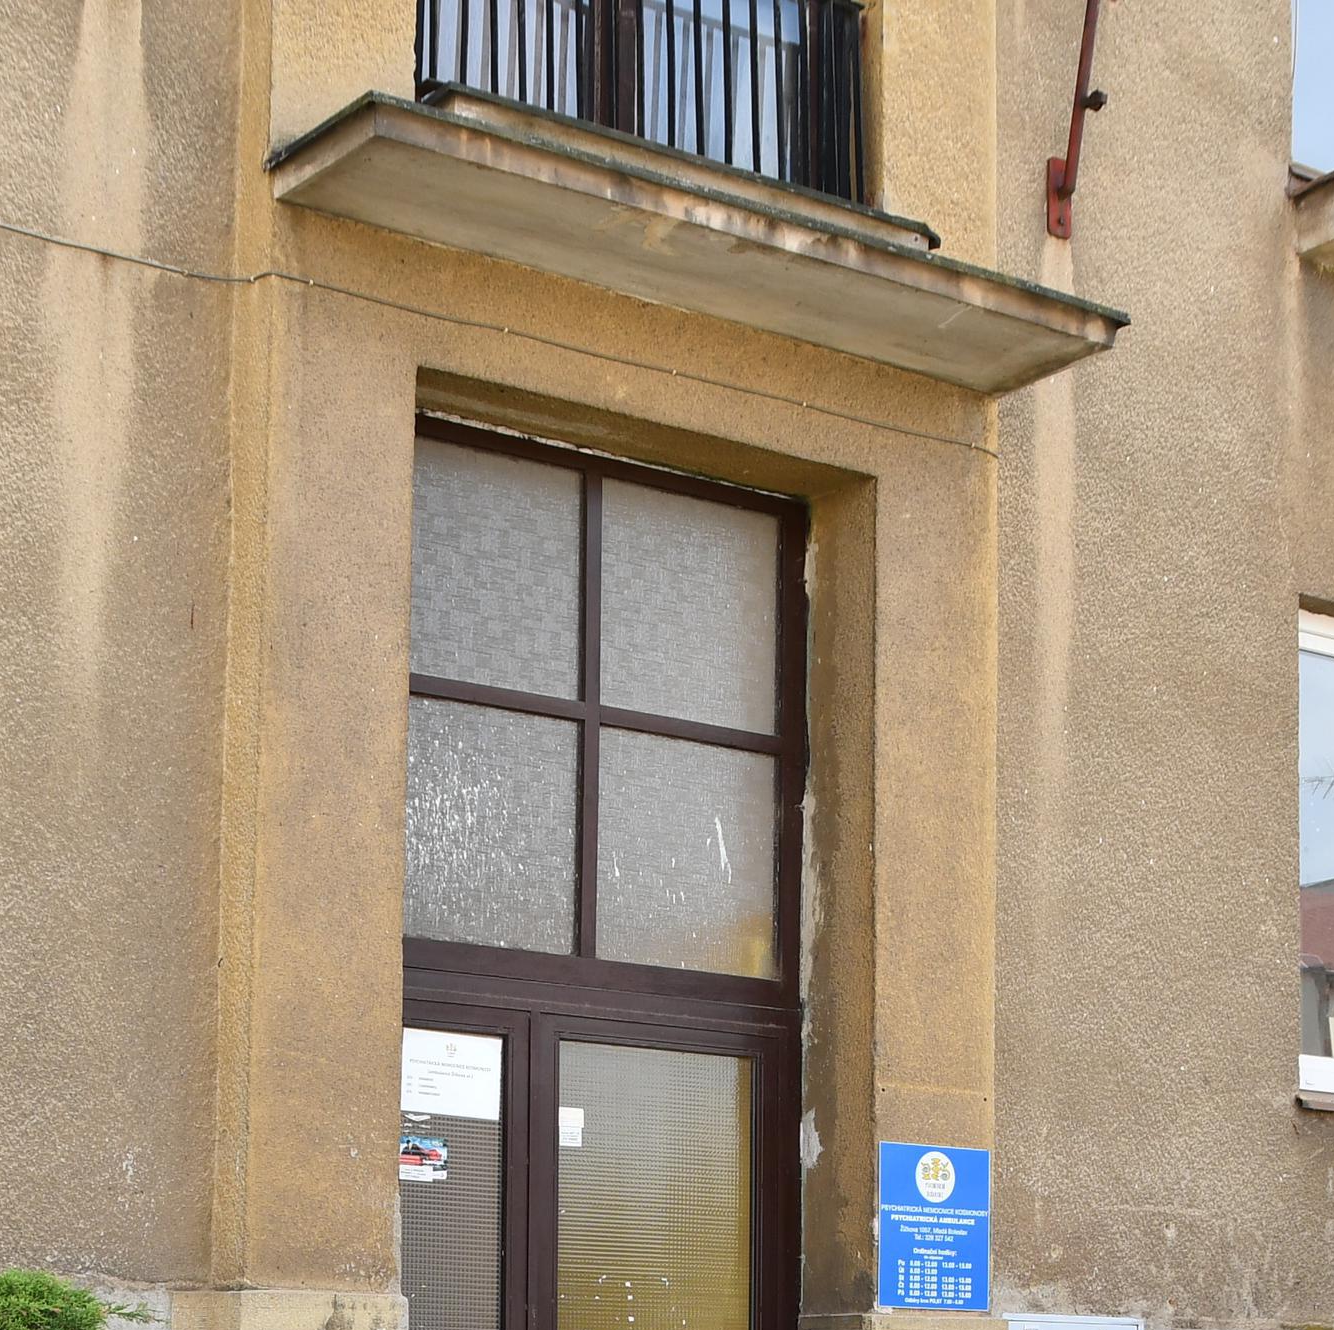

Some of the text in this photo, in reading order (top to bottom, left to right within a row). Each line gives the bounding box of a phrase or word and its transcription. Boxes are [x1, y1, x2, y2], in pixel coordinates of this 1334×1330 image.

[881, 1204, 922, 1212] PSYCHIATRICKÁ
[890, 1214, 975, 1226] PSYCHIATRICKÁ AMBULANCE
